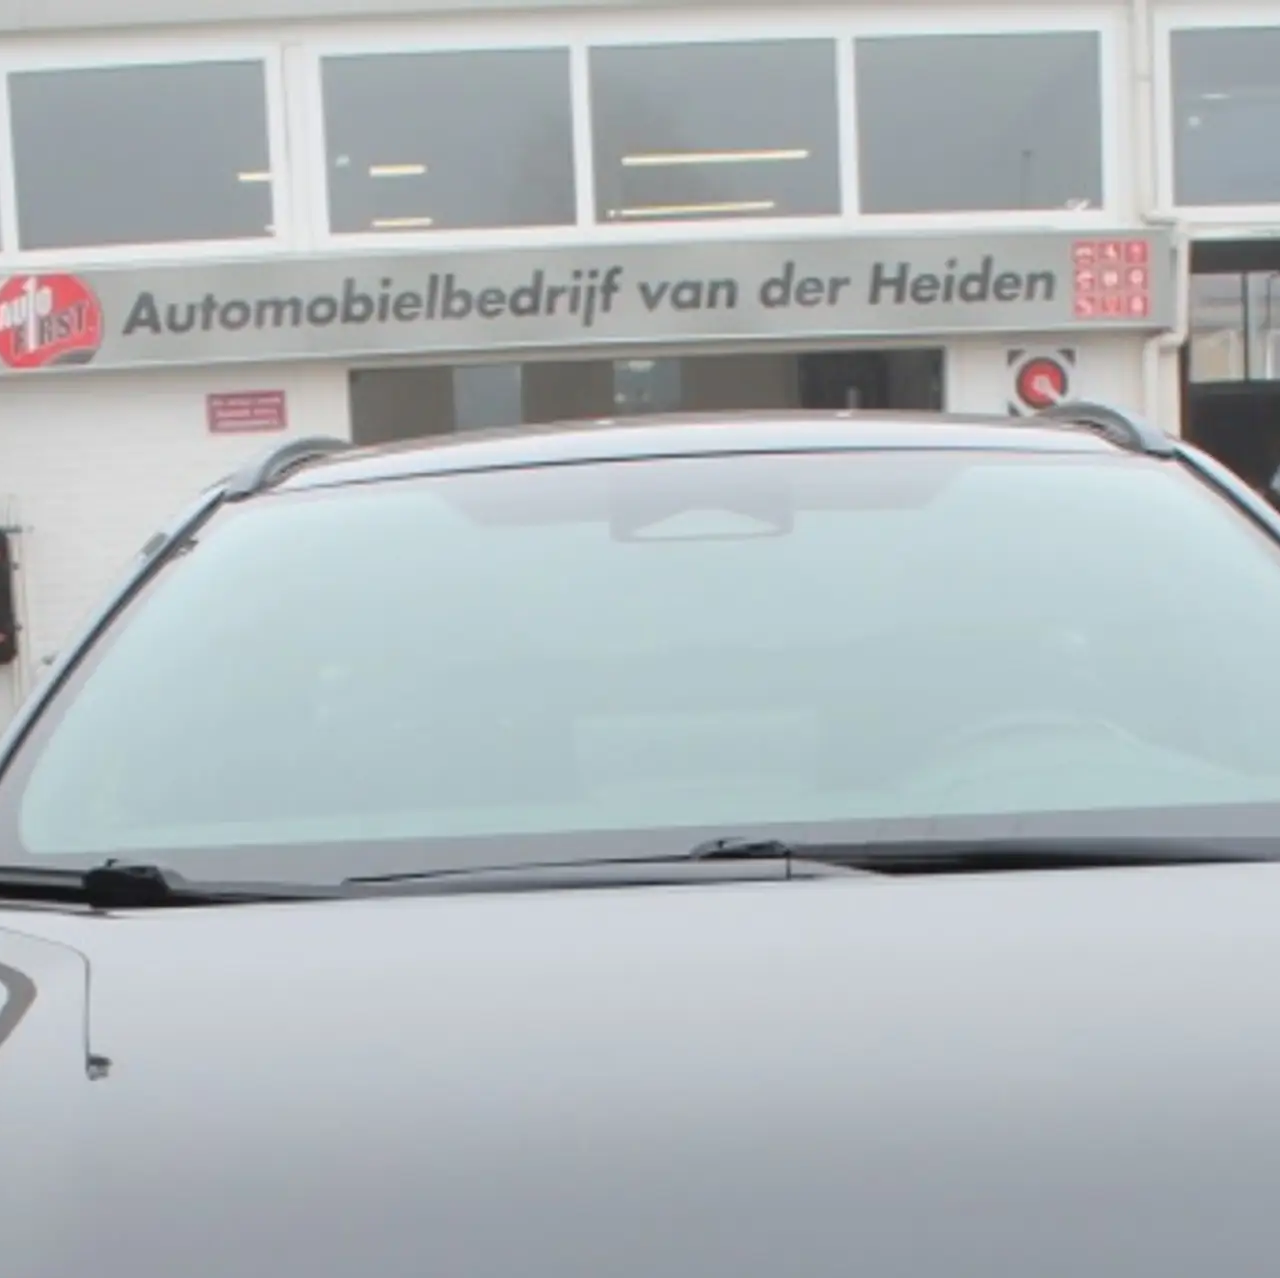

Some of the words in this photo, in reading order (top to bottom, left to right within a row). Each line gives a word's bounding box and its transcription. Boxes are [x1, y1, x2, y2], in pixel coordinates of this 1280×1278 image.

[122, 266, 625, 335] Automobielbedrijf
[637, 278, 739, 312] van
[759, 261, 851, 308] der
[868, 255, 1057, 304] Heiden
